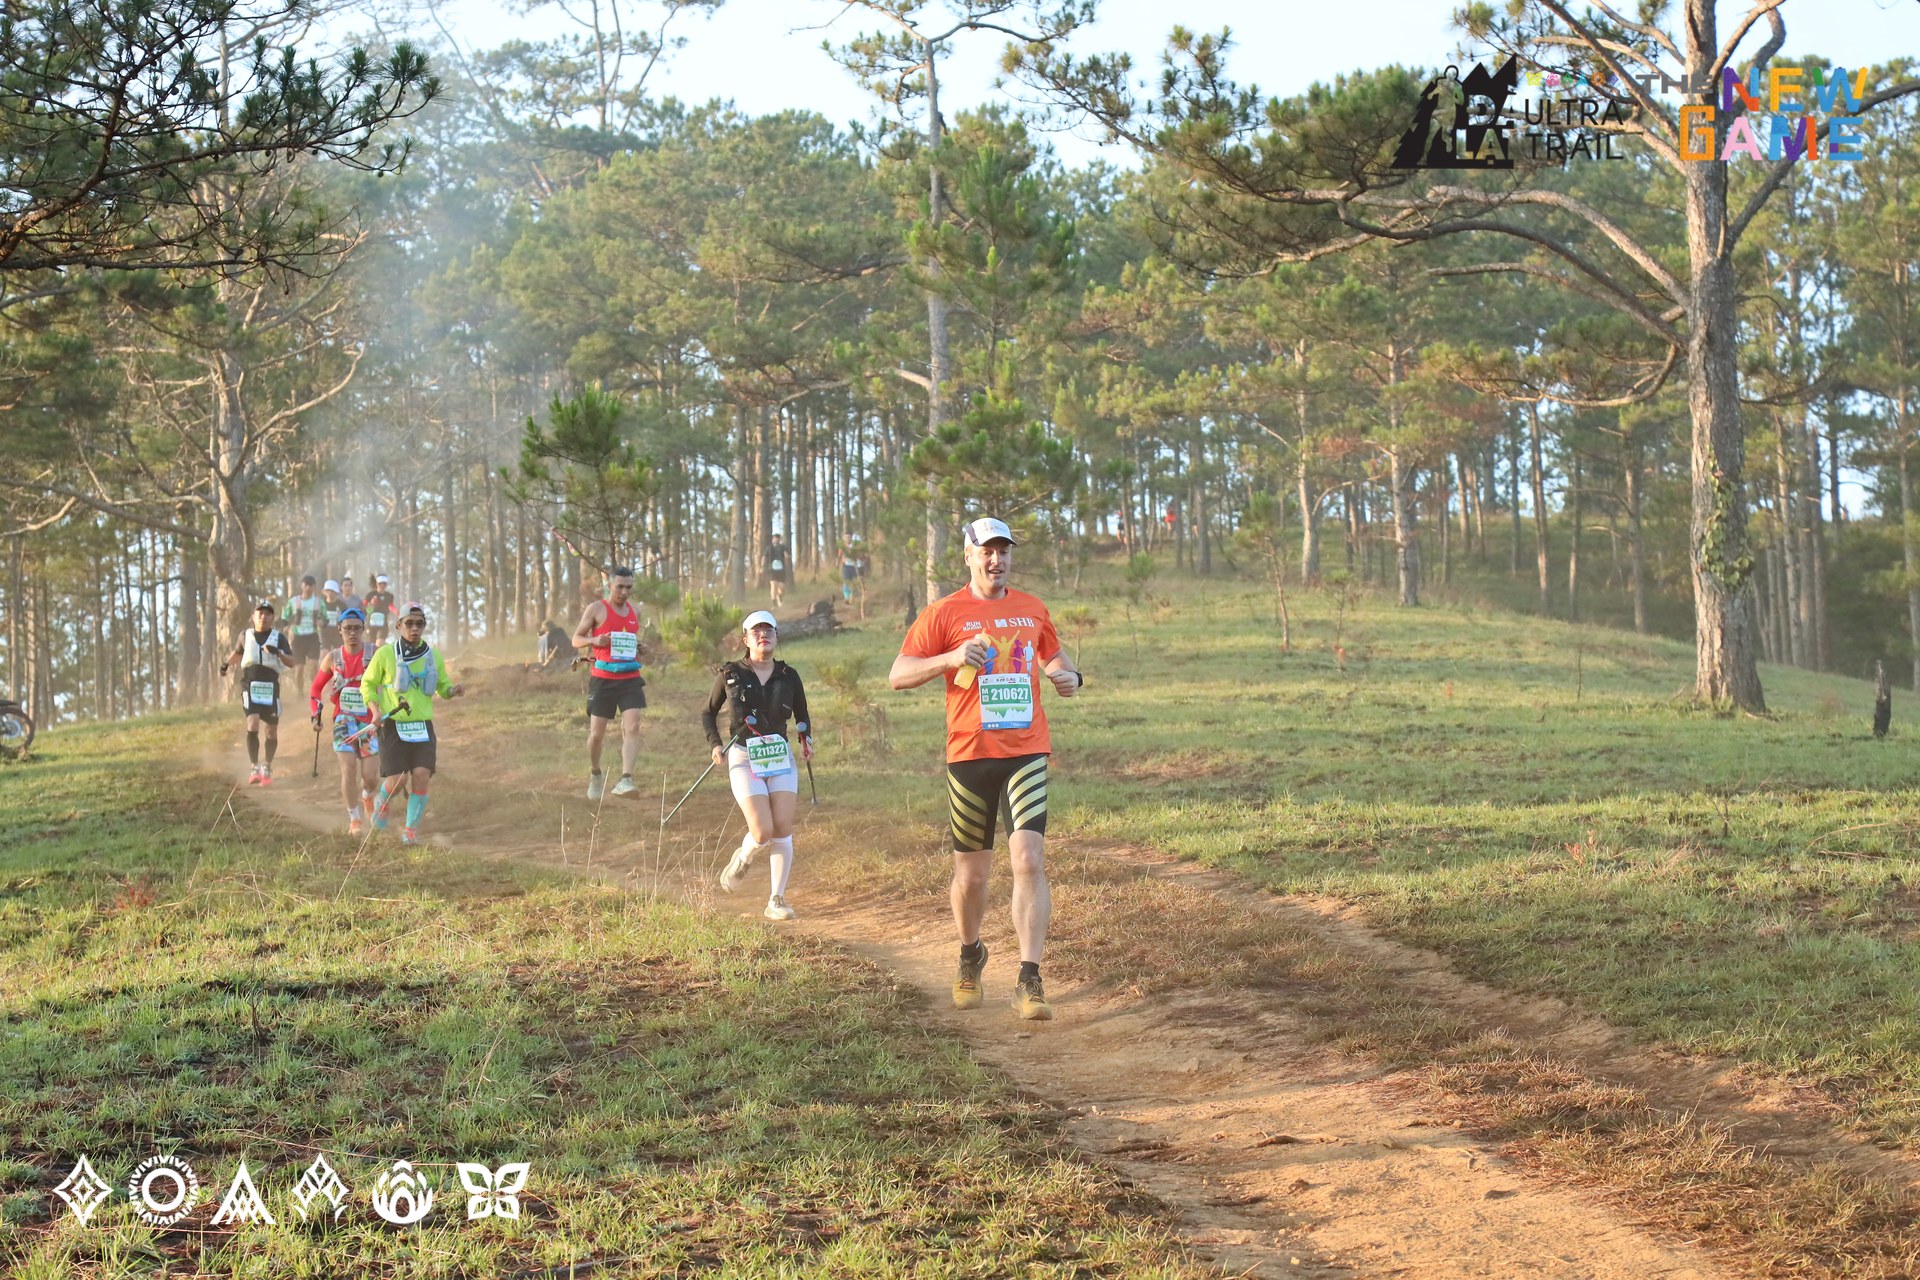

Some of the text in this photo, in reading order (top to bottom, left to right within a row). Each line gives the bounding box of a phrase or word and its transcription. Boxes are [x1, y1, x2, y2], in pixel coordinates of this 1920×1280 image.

[1008, 617, 1035, 628] SHB
[990, 687, 1029, 701] 210627
[756, 744, 785, 757] 211322
